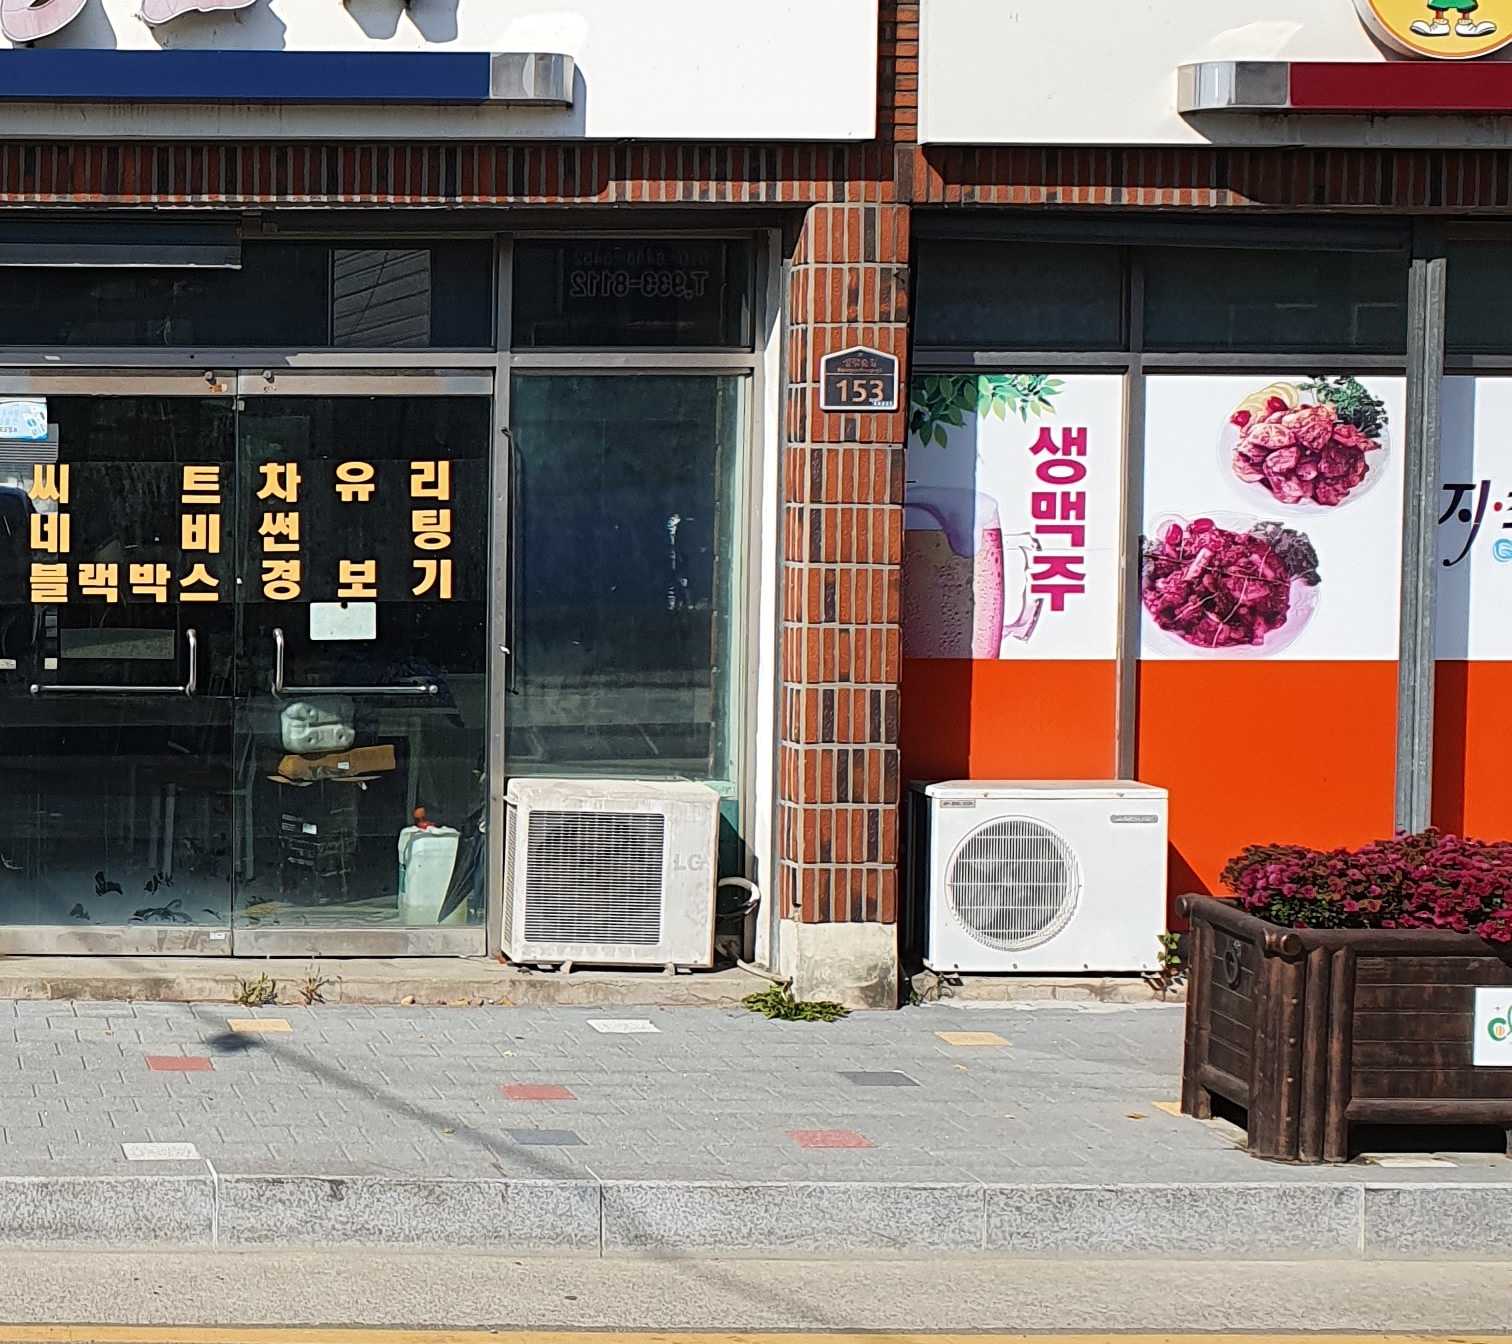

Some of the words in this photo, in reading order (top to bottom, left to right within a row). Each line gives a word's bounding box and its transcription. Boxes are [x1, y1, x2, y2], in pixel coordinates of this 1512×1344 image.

[835, 379, 884, 403] 153
[1028, 426, 1088, 613] 생맥주
[29, 563, 220, 603] 블랙박스
[673, 853, 704, 871] LG
